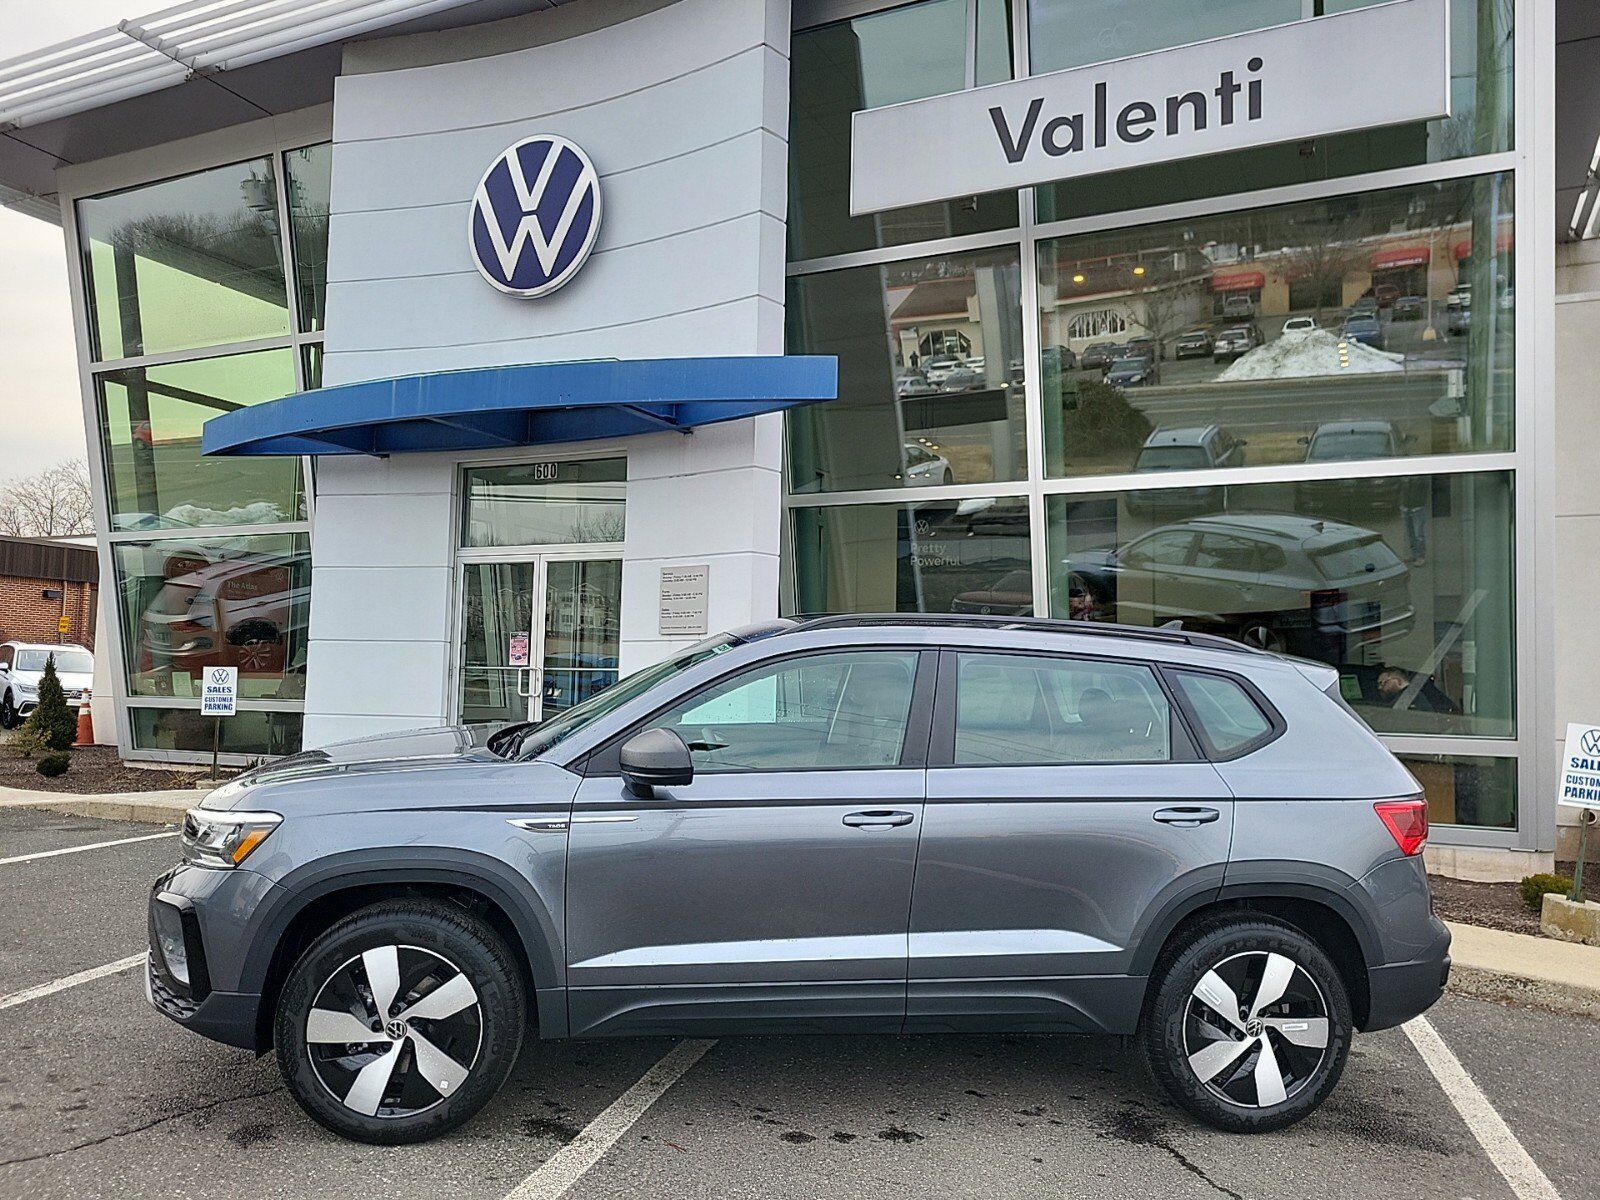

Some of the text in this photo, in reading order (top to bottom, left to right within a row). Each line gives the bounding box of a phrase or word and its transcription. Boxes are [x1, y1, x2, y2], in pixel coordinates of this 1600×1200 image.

[988, 57, 1263, 164] Valenti
[536, 464, 557, 478] 600
[911, 543, 946, 555] Pretty
[910, 556, 961, 566] Powerful
[204, 703, 233, 711] PARKING
